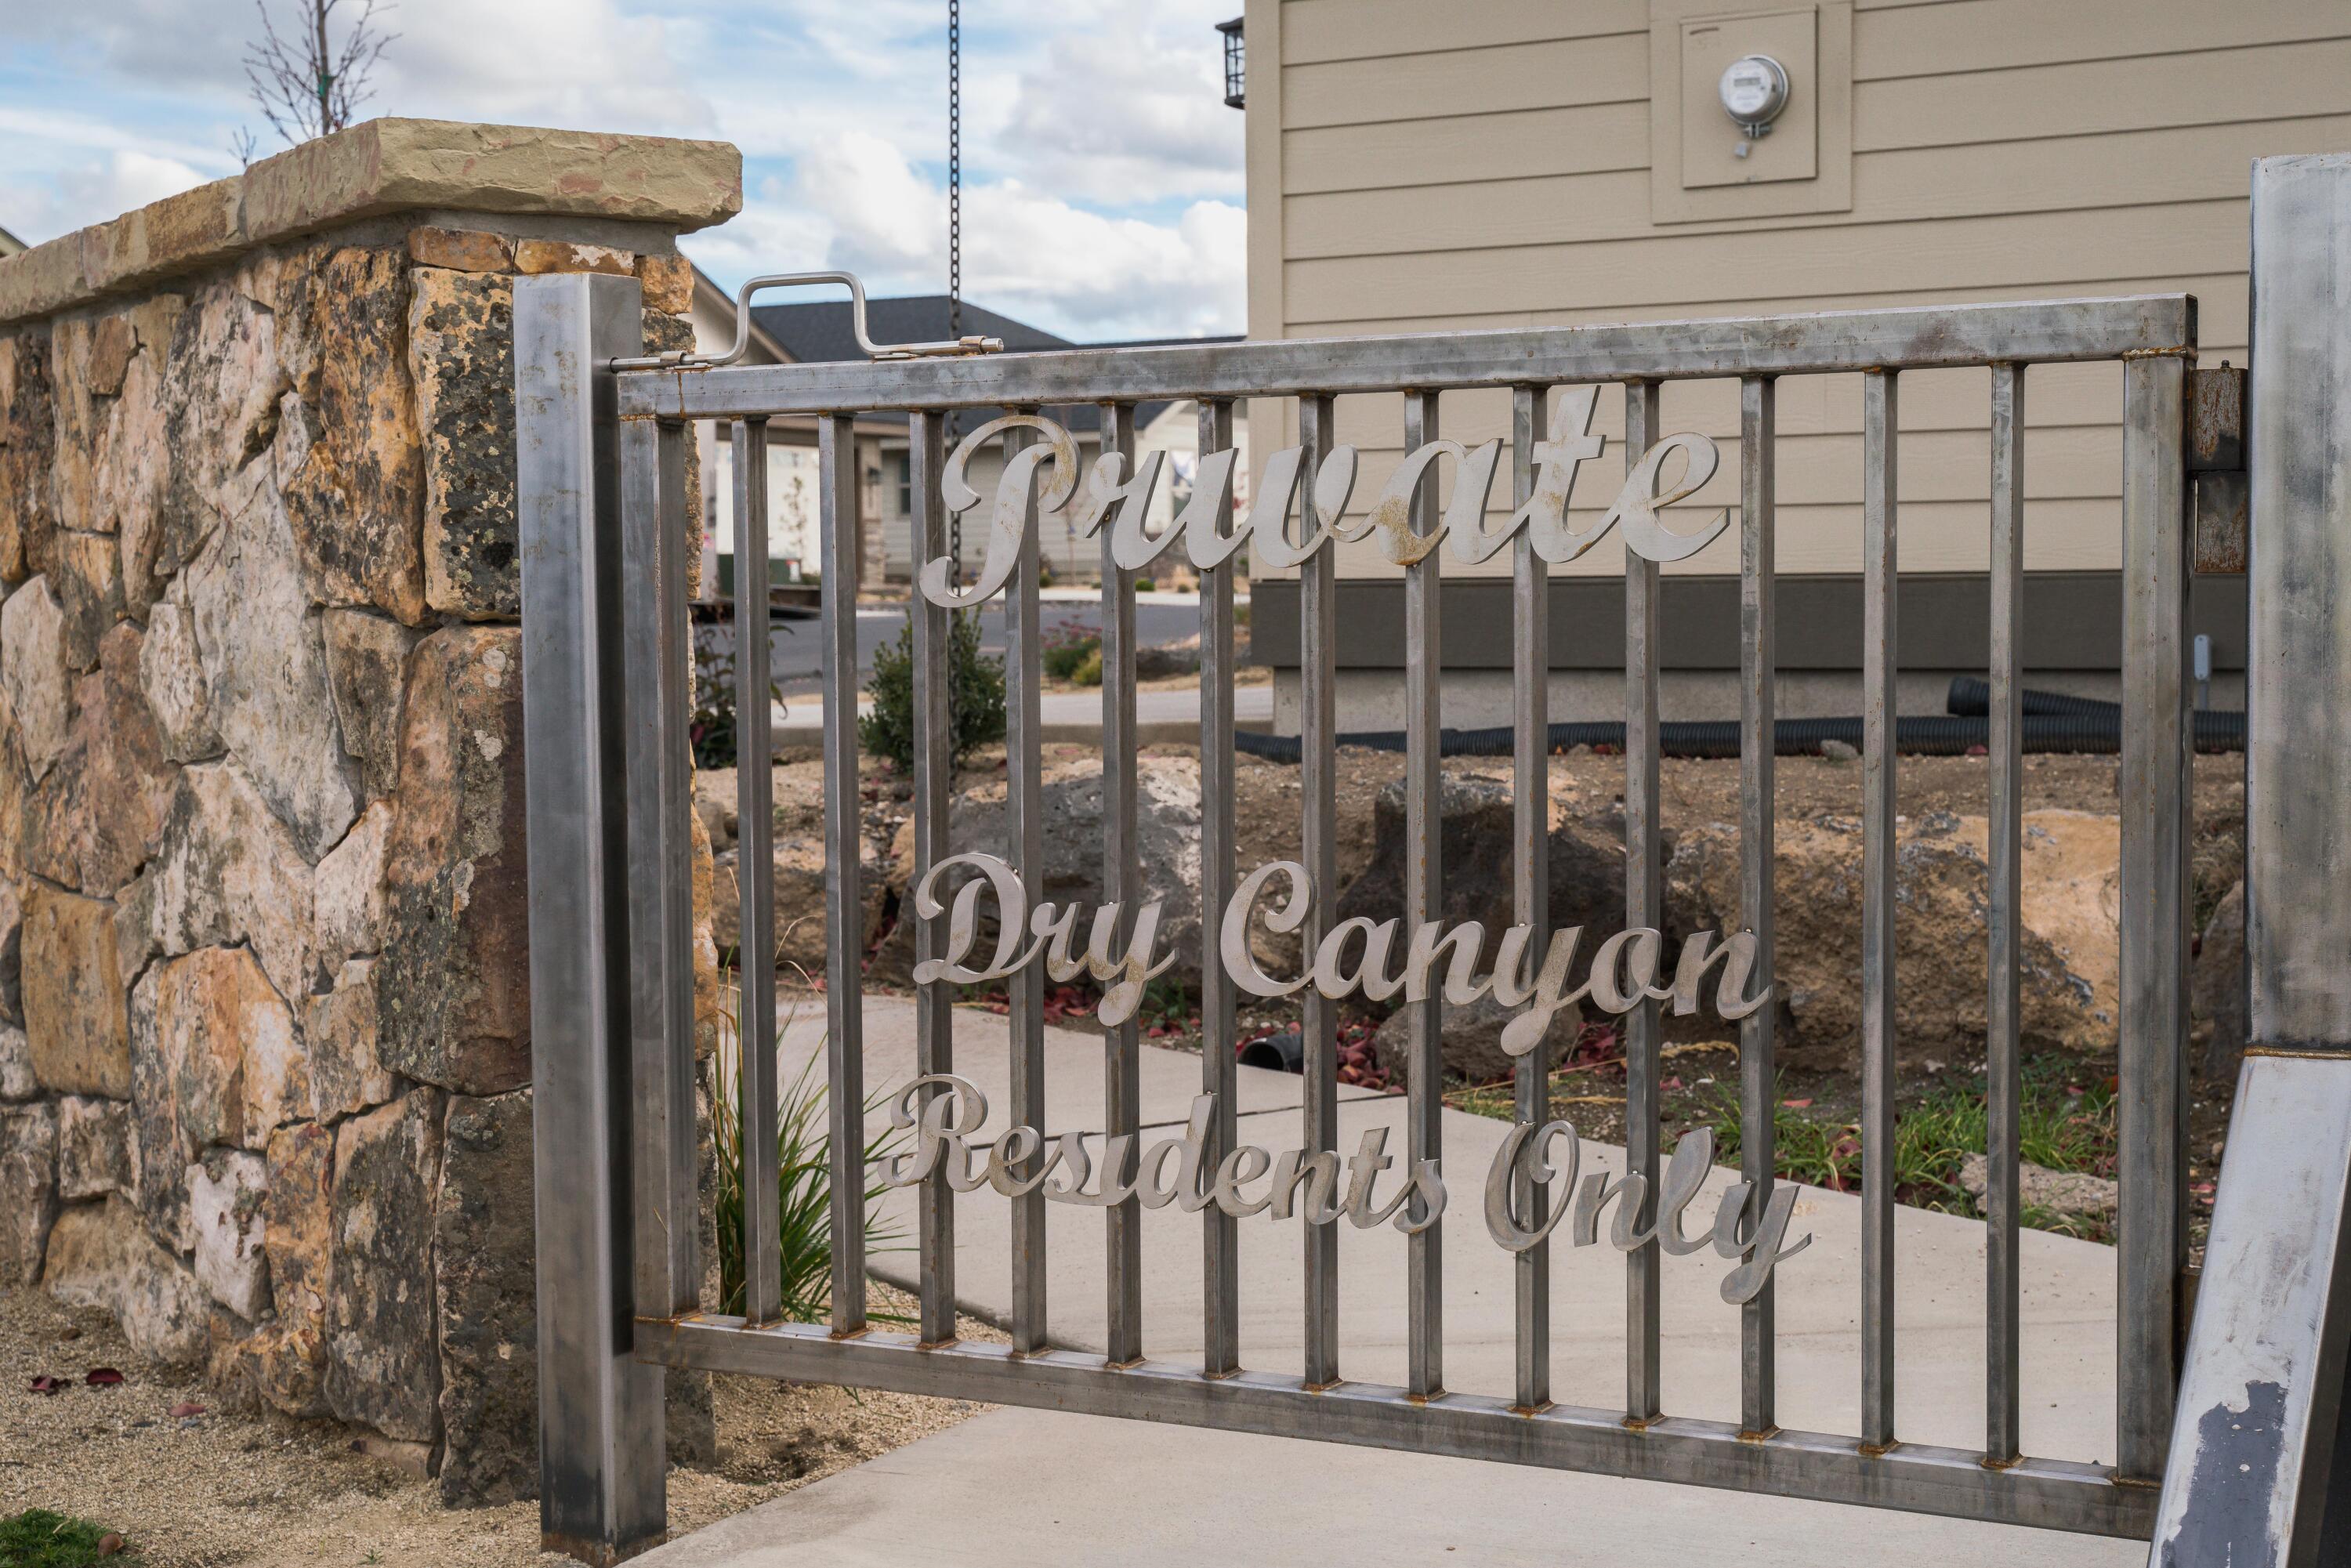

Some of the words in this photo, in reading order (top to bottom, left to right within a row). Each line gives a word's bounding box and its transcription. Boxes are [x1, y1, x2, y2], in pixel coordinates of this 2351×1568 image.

[920, 385, 1730, 608] Private
[913, 853, 1178, 1027] Dry
[1220, 861, 1773, 1056] Canyon
[878, 1074, 1447, 1234] Residents
[1485, 1121, 1812, 1305] Only
